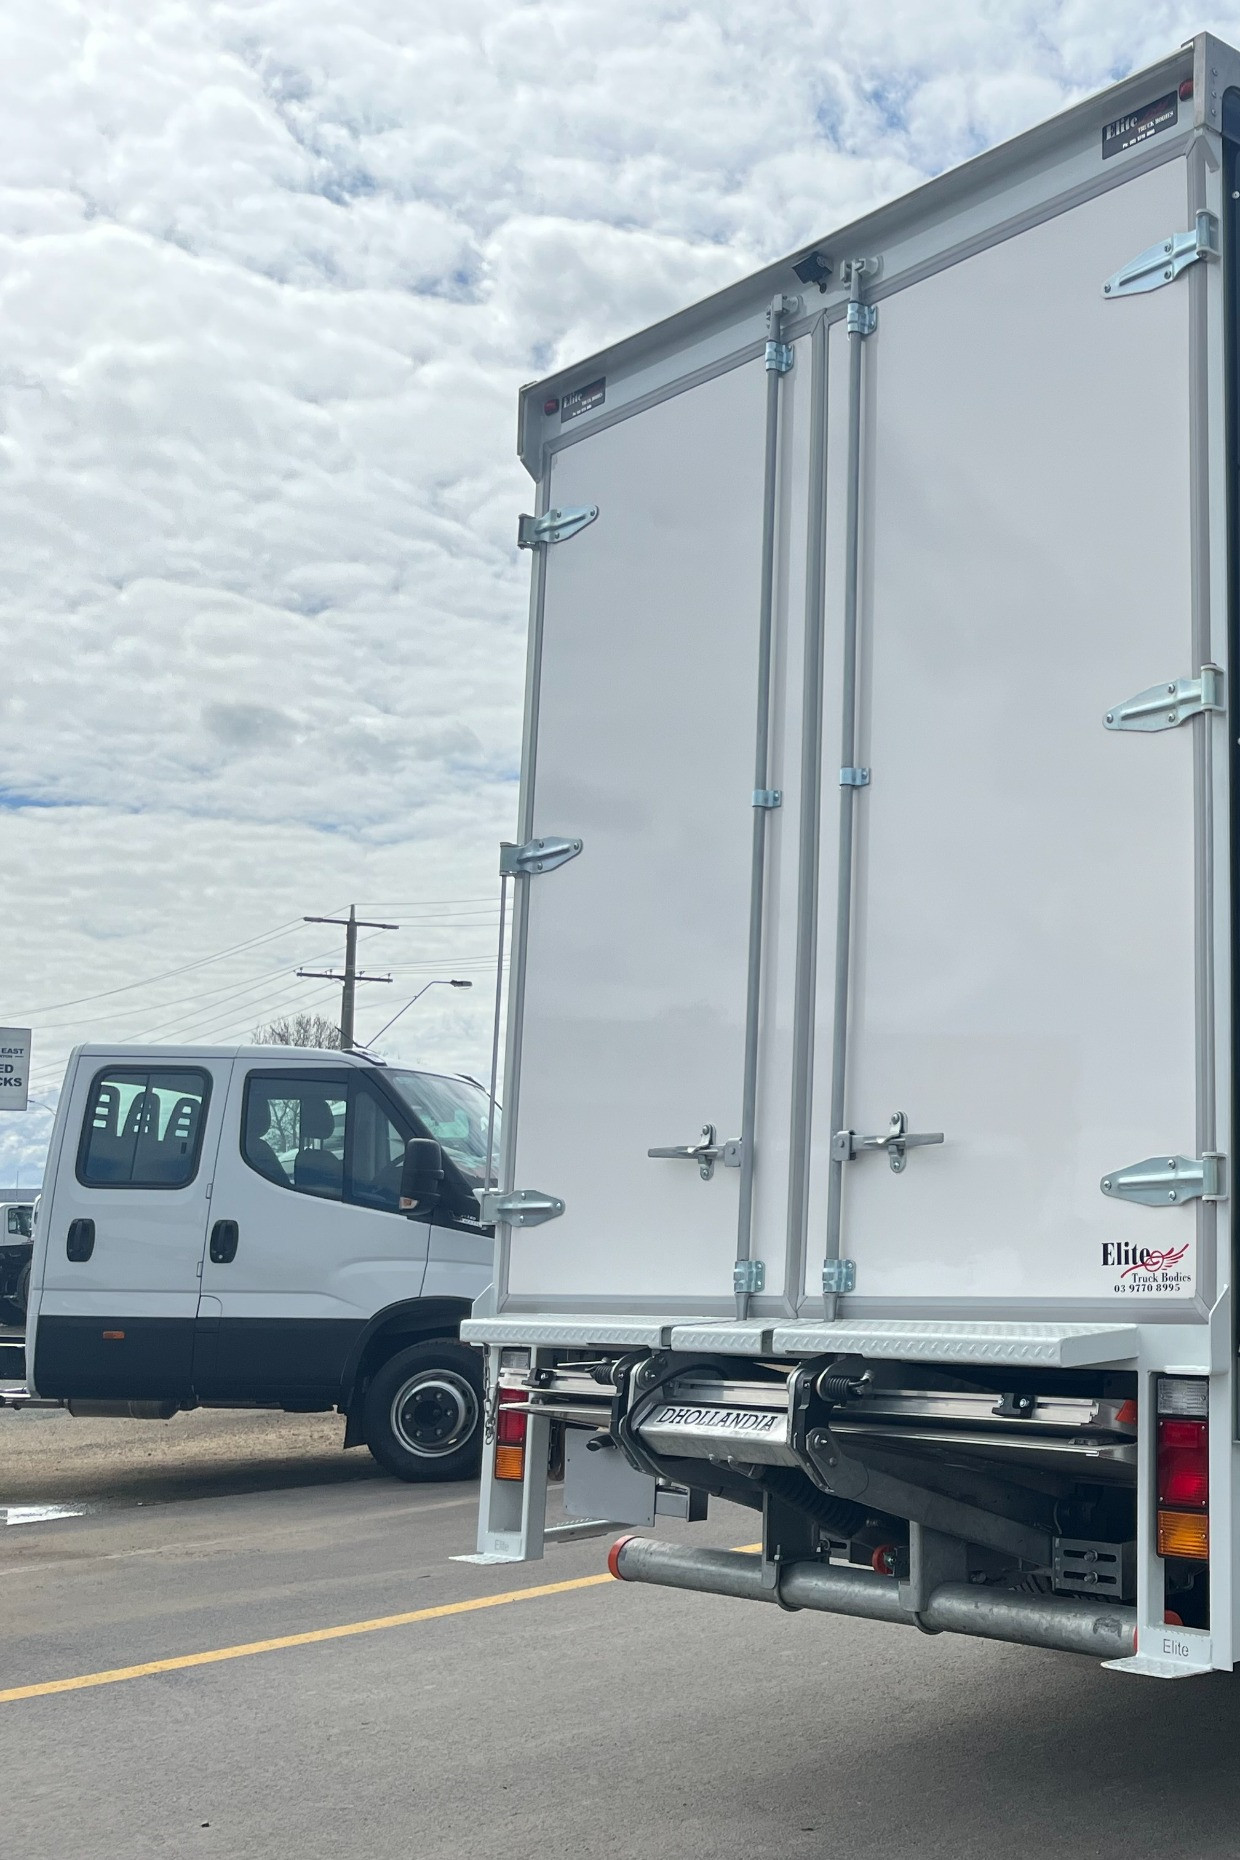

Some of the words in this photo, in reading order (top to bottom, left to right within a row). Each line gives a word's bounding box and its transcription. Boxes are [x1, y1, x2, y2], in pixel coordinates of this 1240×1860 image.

[1105, 116, 1138, 141] Elite
[1101, 1241, 1151, 1267] Elite
[1114, 1284, 1126, 1293] 03
[1129, 1284, 1153, 1293] 9770
[1155, 1283, 1181, 1292] 8995
[1132, 1272, 1159, 1283] Truck
[1161, 1272, 1192, 1283] Bodies
[656, 1408, 778, 1432] DHOLLANDIA
[1163, 1638, 1190, 1657] Elite
